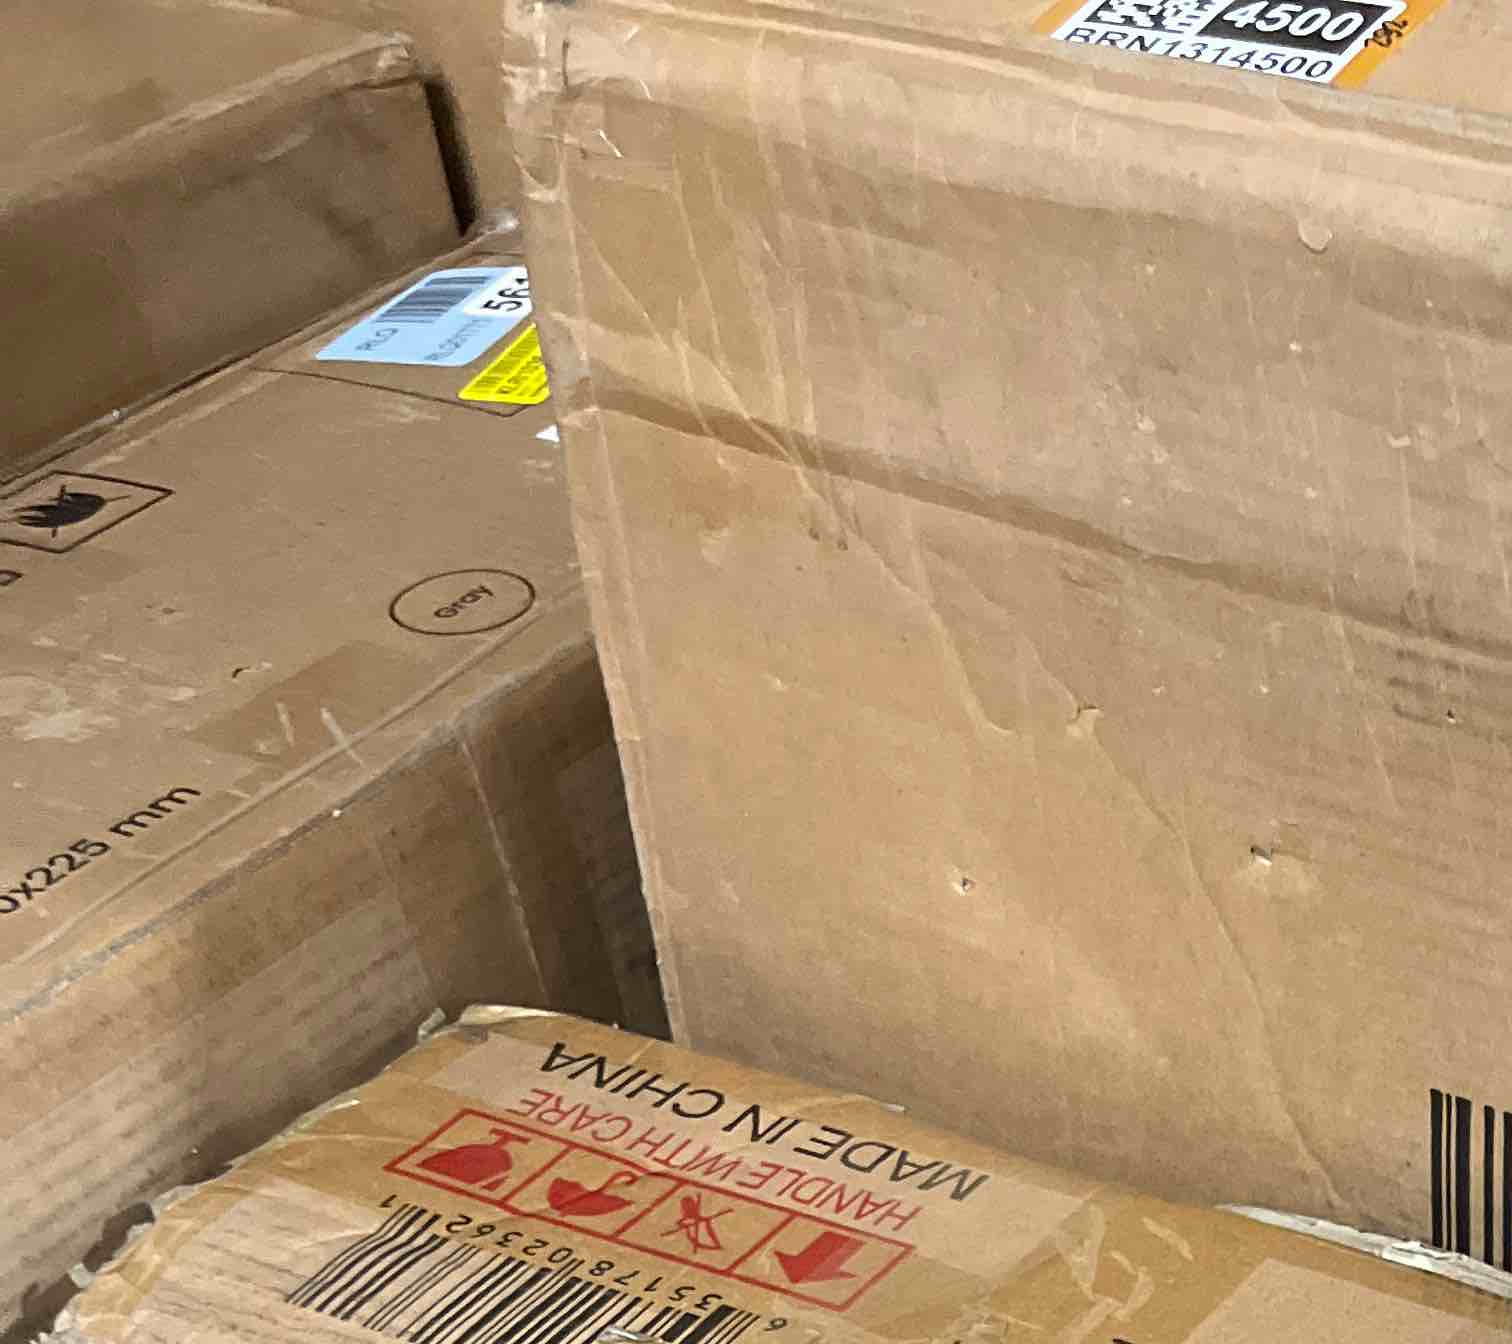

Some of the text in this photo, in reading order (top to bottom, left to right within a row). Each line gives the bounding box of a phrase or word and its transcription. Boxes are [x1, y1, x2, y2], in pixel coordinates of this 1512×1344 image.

[1220, 0, 1364, 42] 4500
[433, 583, 495, 620] Gray
[109, 785, 202, 838] mm
[539, 1041, 990, 1201] MADE IN CHINA
[505, 1087, 921, 1230] HANDLE WITH CARE
[444, 1213, 571, 1266] 02362
[587, 1259, 724, 1311] 35178
